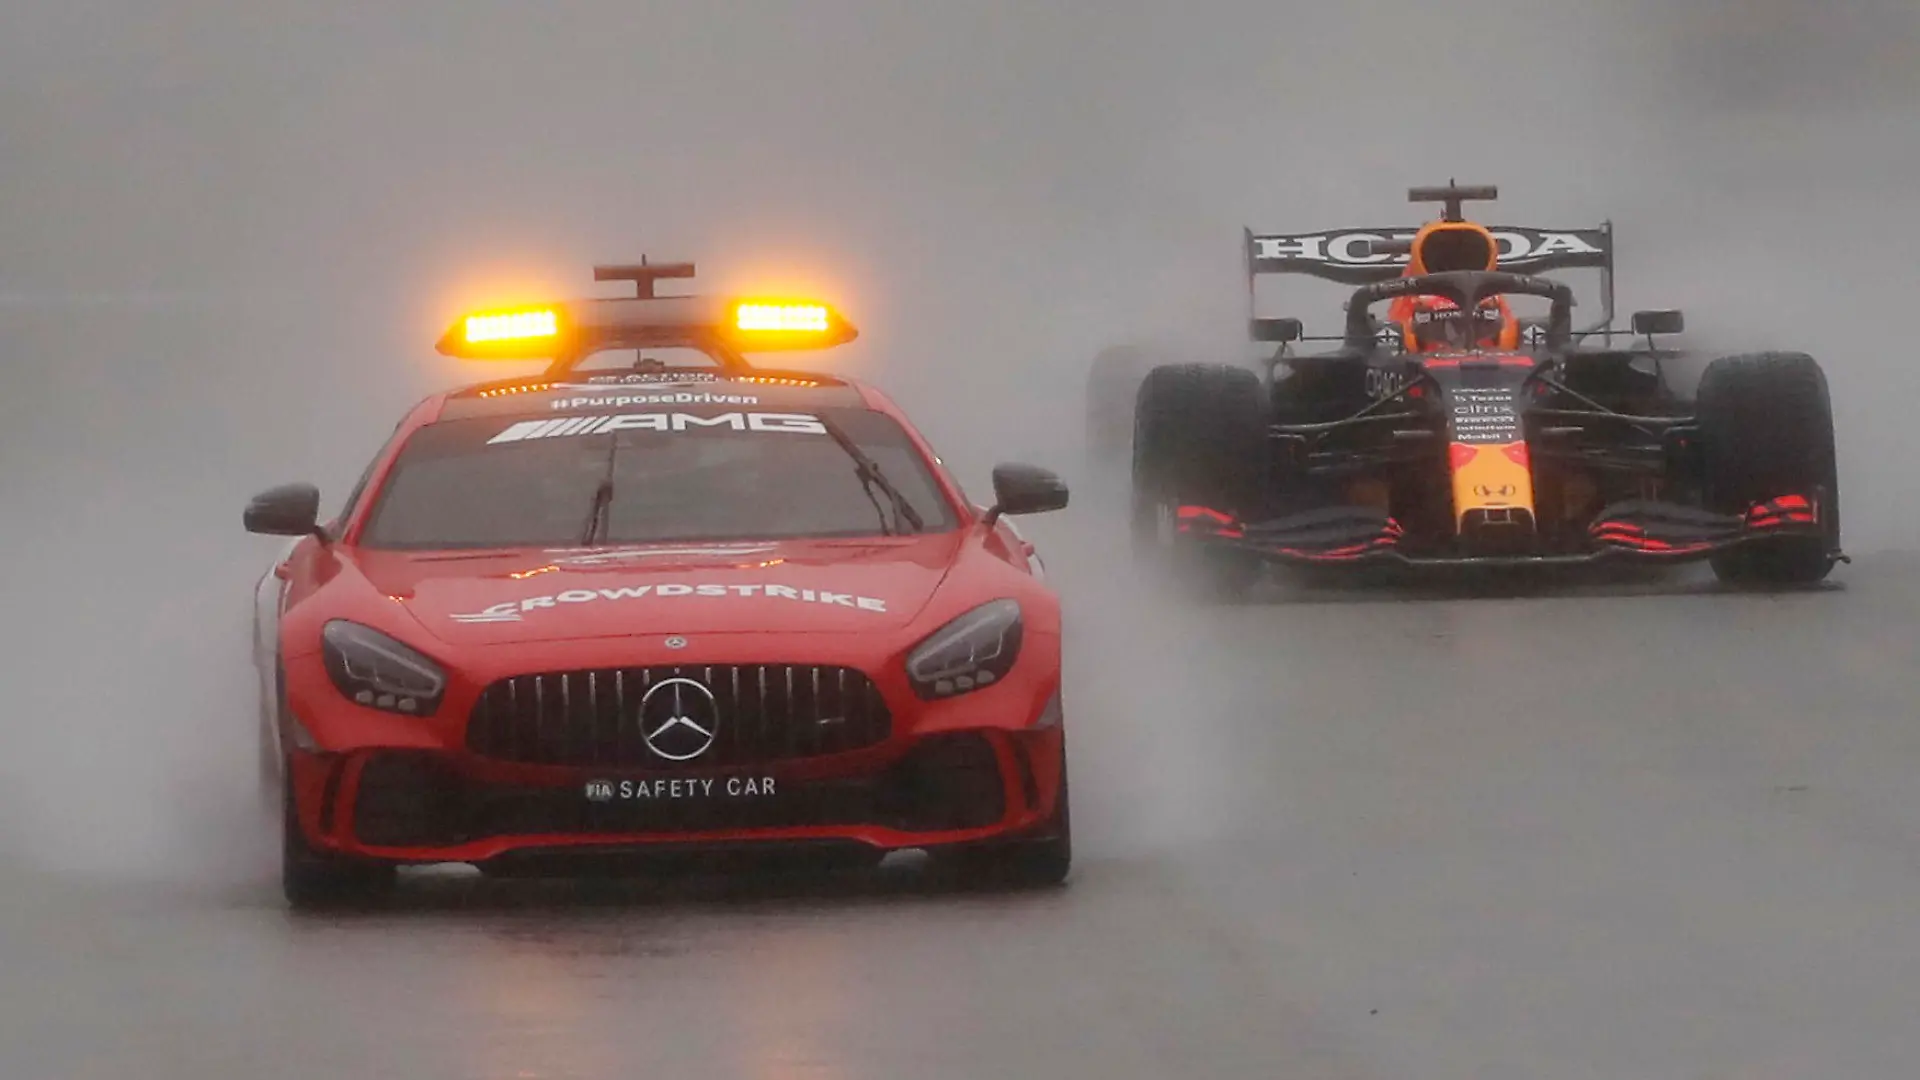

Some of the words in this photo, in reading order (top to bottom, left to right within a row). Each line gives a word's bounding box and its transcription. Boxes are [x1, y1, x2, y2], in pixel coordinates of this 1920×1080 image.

[1254, 232, 1603, 264] HODA
[551, 391, 758, 410] #PurposeDriven
[593, 412, 827, 434] AMG
[482, 583, 888, 617] CROWDSTRIKE
[619, 778, 714, 799] SAFETY
[726, 776, 776, 796] CAR
